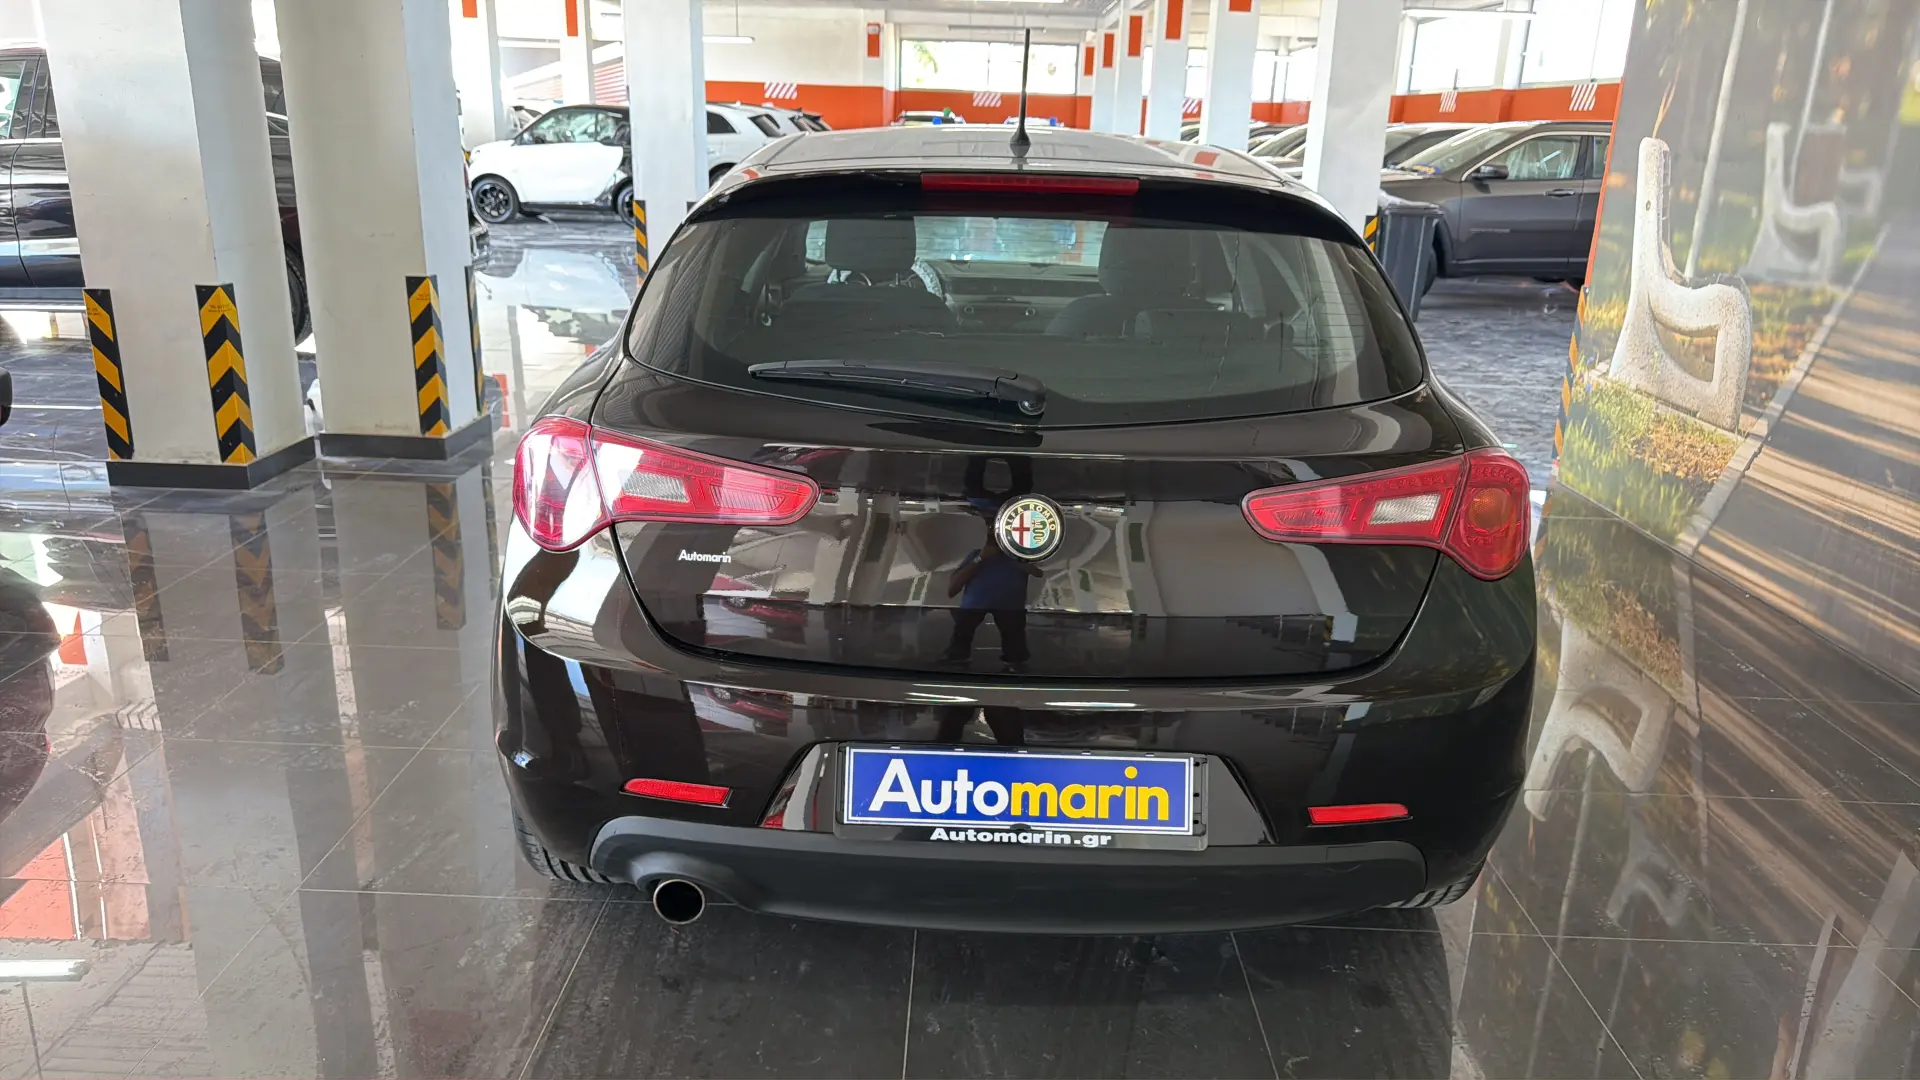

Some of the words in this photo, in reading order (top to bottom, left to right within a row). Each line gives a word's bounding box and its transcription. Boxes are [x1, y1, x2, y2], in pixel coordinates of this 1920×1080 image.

[1005, 506, 1024, 531] ALFA
[1029, 503, 1056, 530] ROMEO
[678, 549, 731, 563] Automarin
[868, 758, 1169, 821] Automarin
[930, 827, 1112, 848] Automarin.gr
